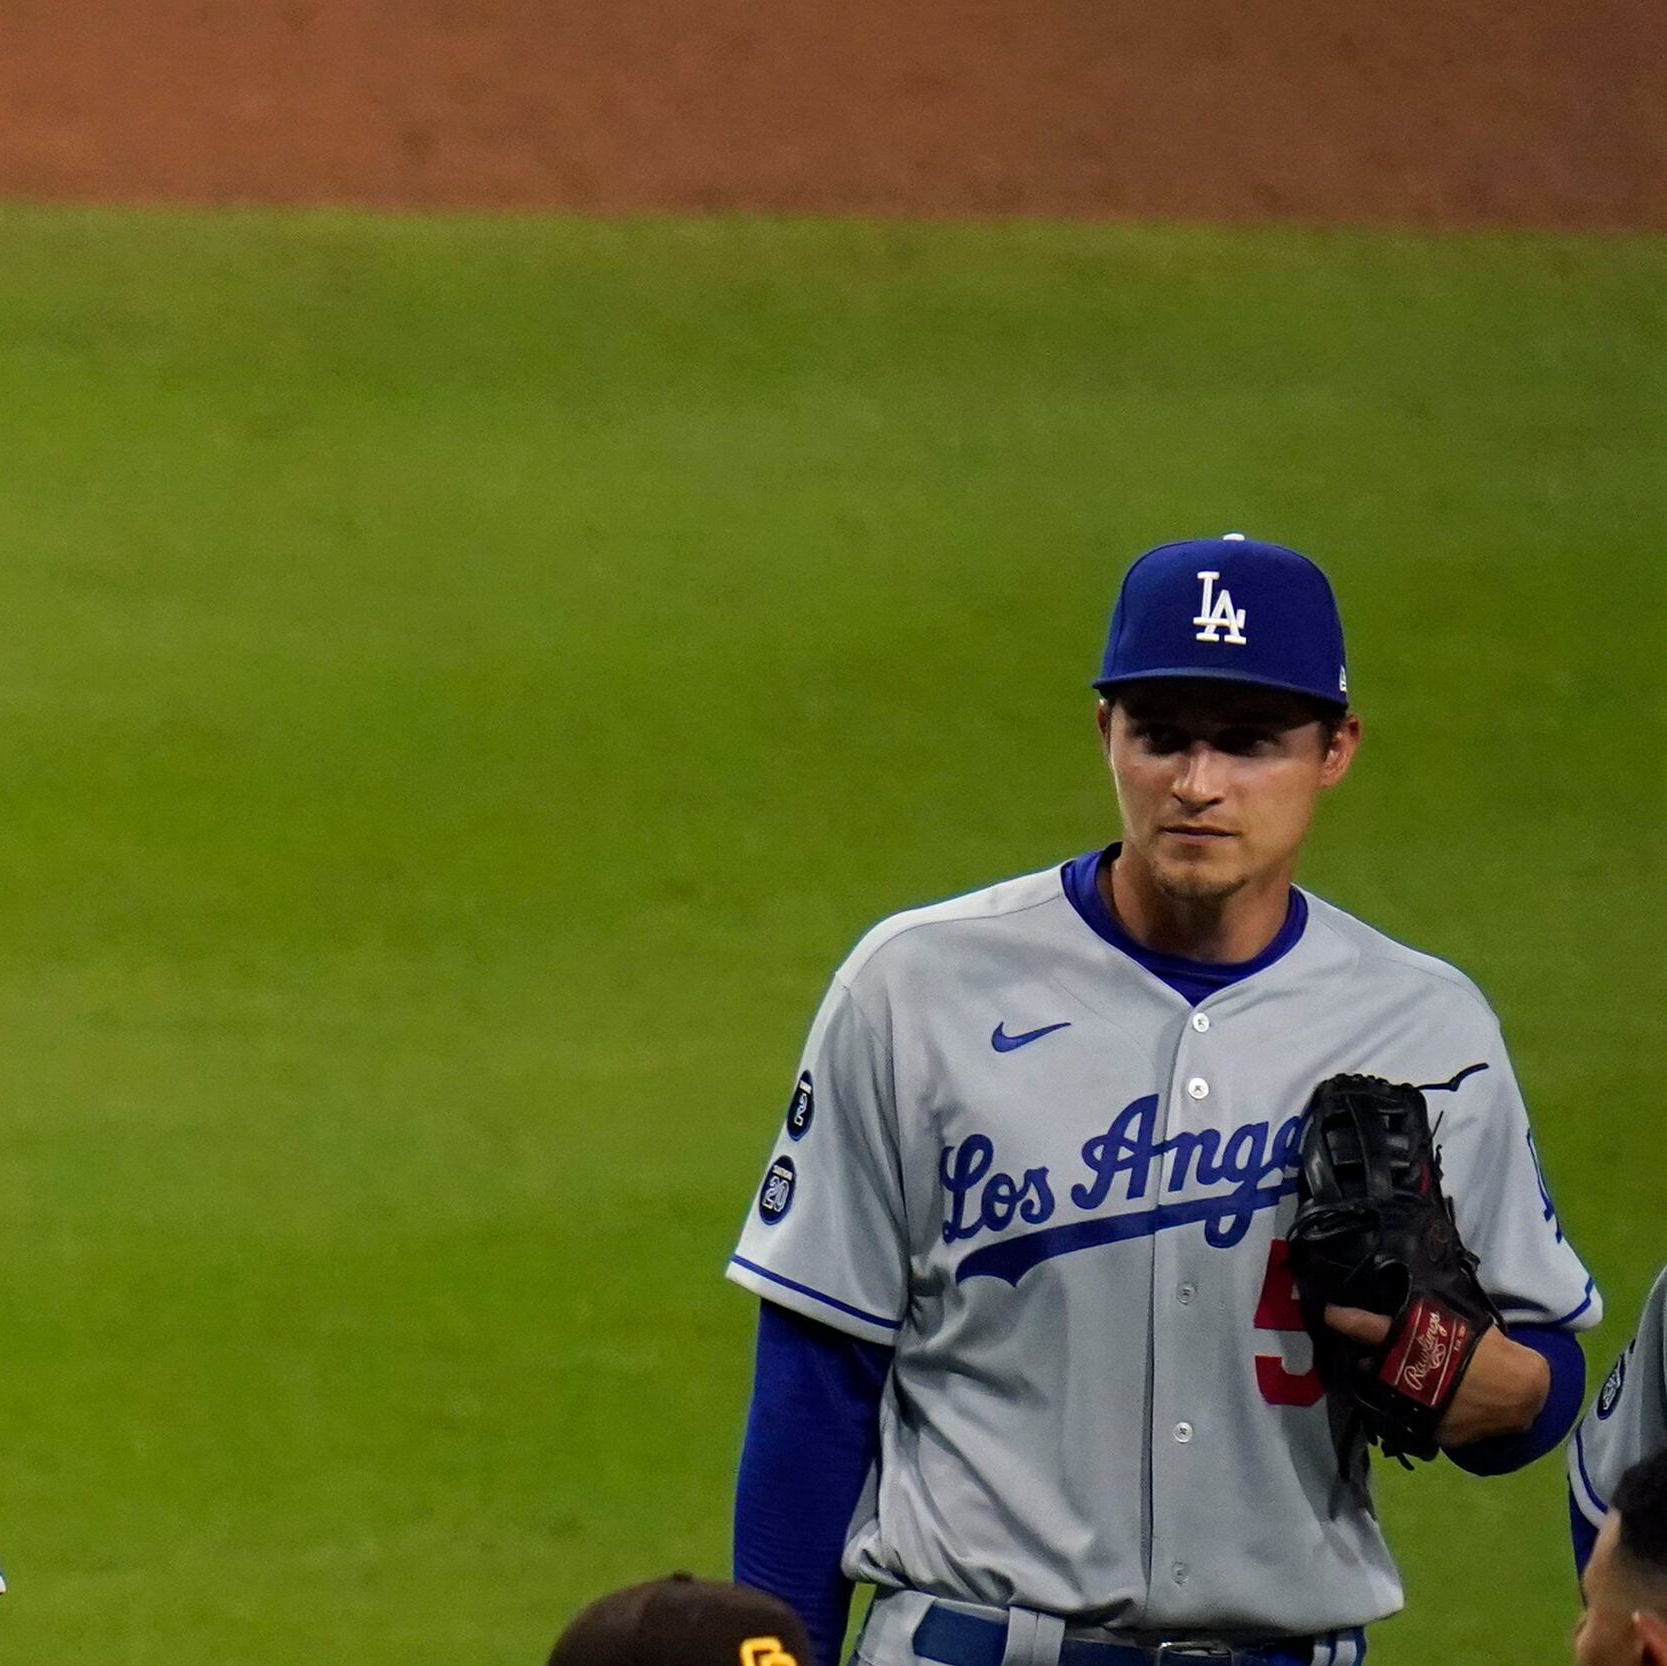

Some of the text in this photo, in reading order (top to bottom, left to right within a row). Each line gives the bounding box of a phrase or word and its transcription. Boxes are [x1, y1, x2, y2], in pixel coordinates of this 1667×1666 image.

[1193, 571, 1247, 645] LA
[762, 1176, 790, 1213] 20
[940, 1133, 1057, 1245] Los
[1253, 1238, 1329, 1407] 5
